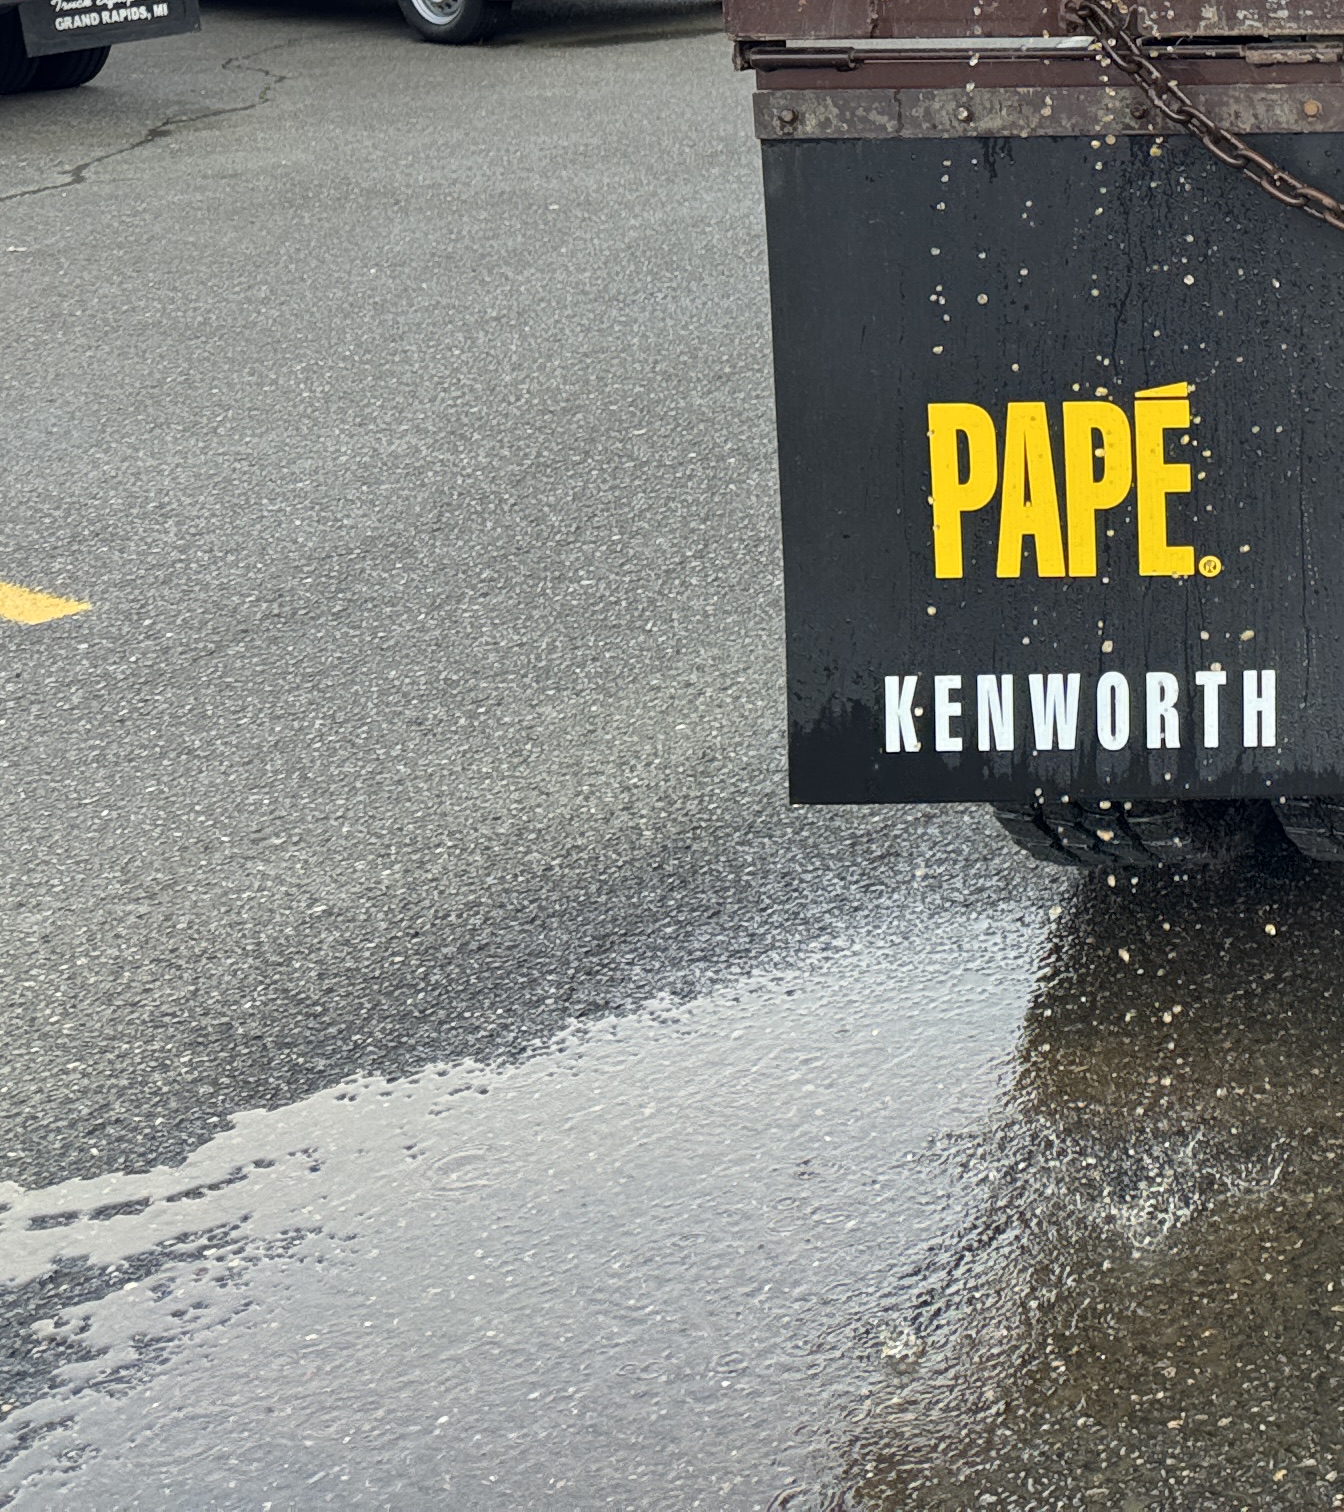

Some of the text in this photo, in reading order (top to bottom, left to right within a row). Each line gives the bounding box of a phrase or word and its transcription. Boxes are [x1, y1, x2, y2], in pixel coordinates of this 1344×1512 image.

[55, 2, 169, 30] GRAND RAPIDS, MI
[884, 670, 1276, 753] KENWORTH
